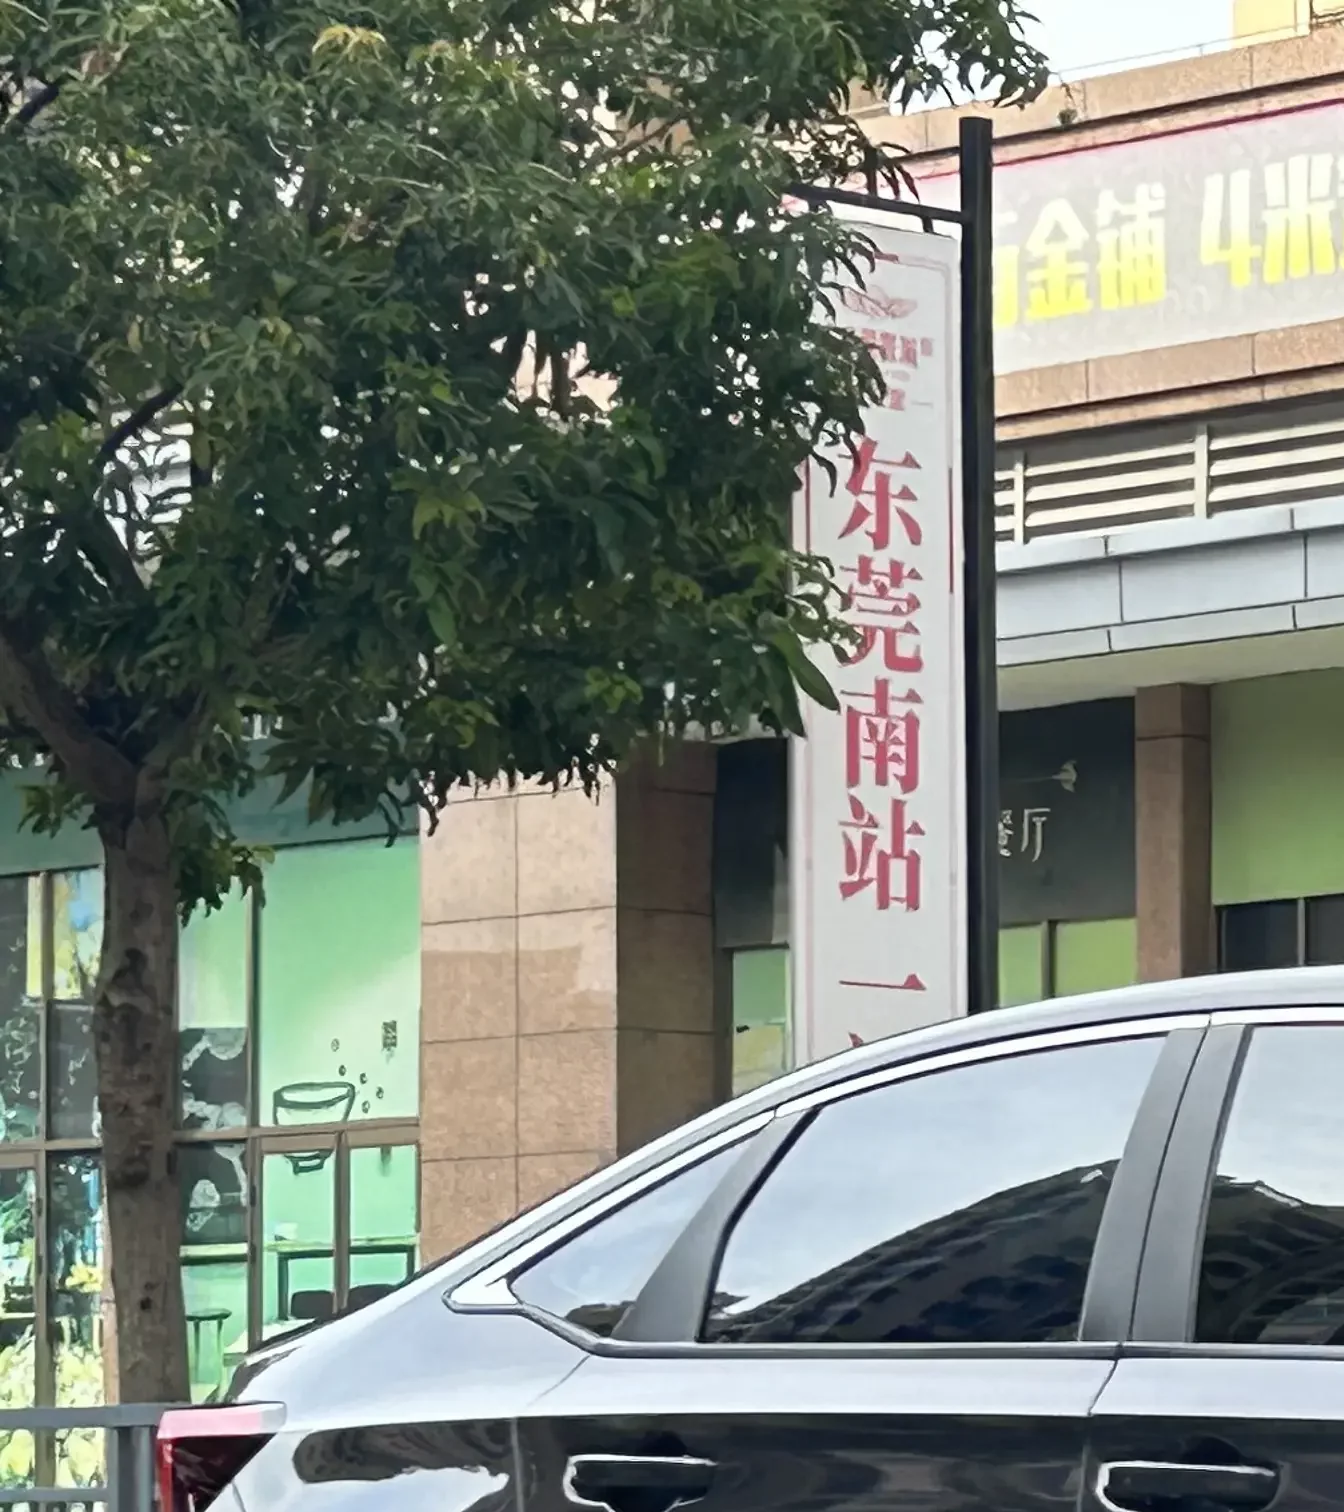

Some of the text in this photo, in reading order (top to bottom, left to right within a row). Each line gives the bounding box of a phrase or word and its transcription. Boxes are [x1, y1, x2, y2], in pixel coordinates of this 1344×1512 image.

[837, 436, 928, 1047] 东莞南站一
